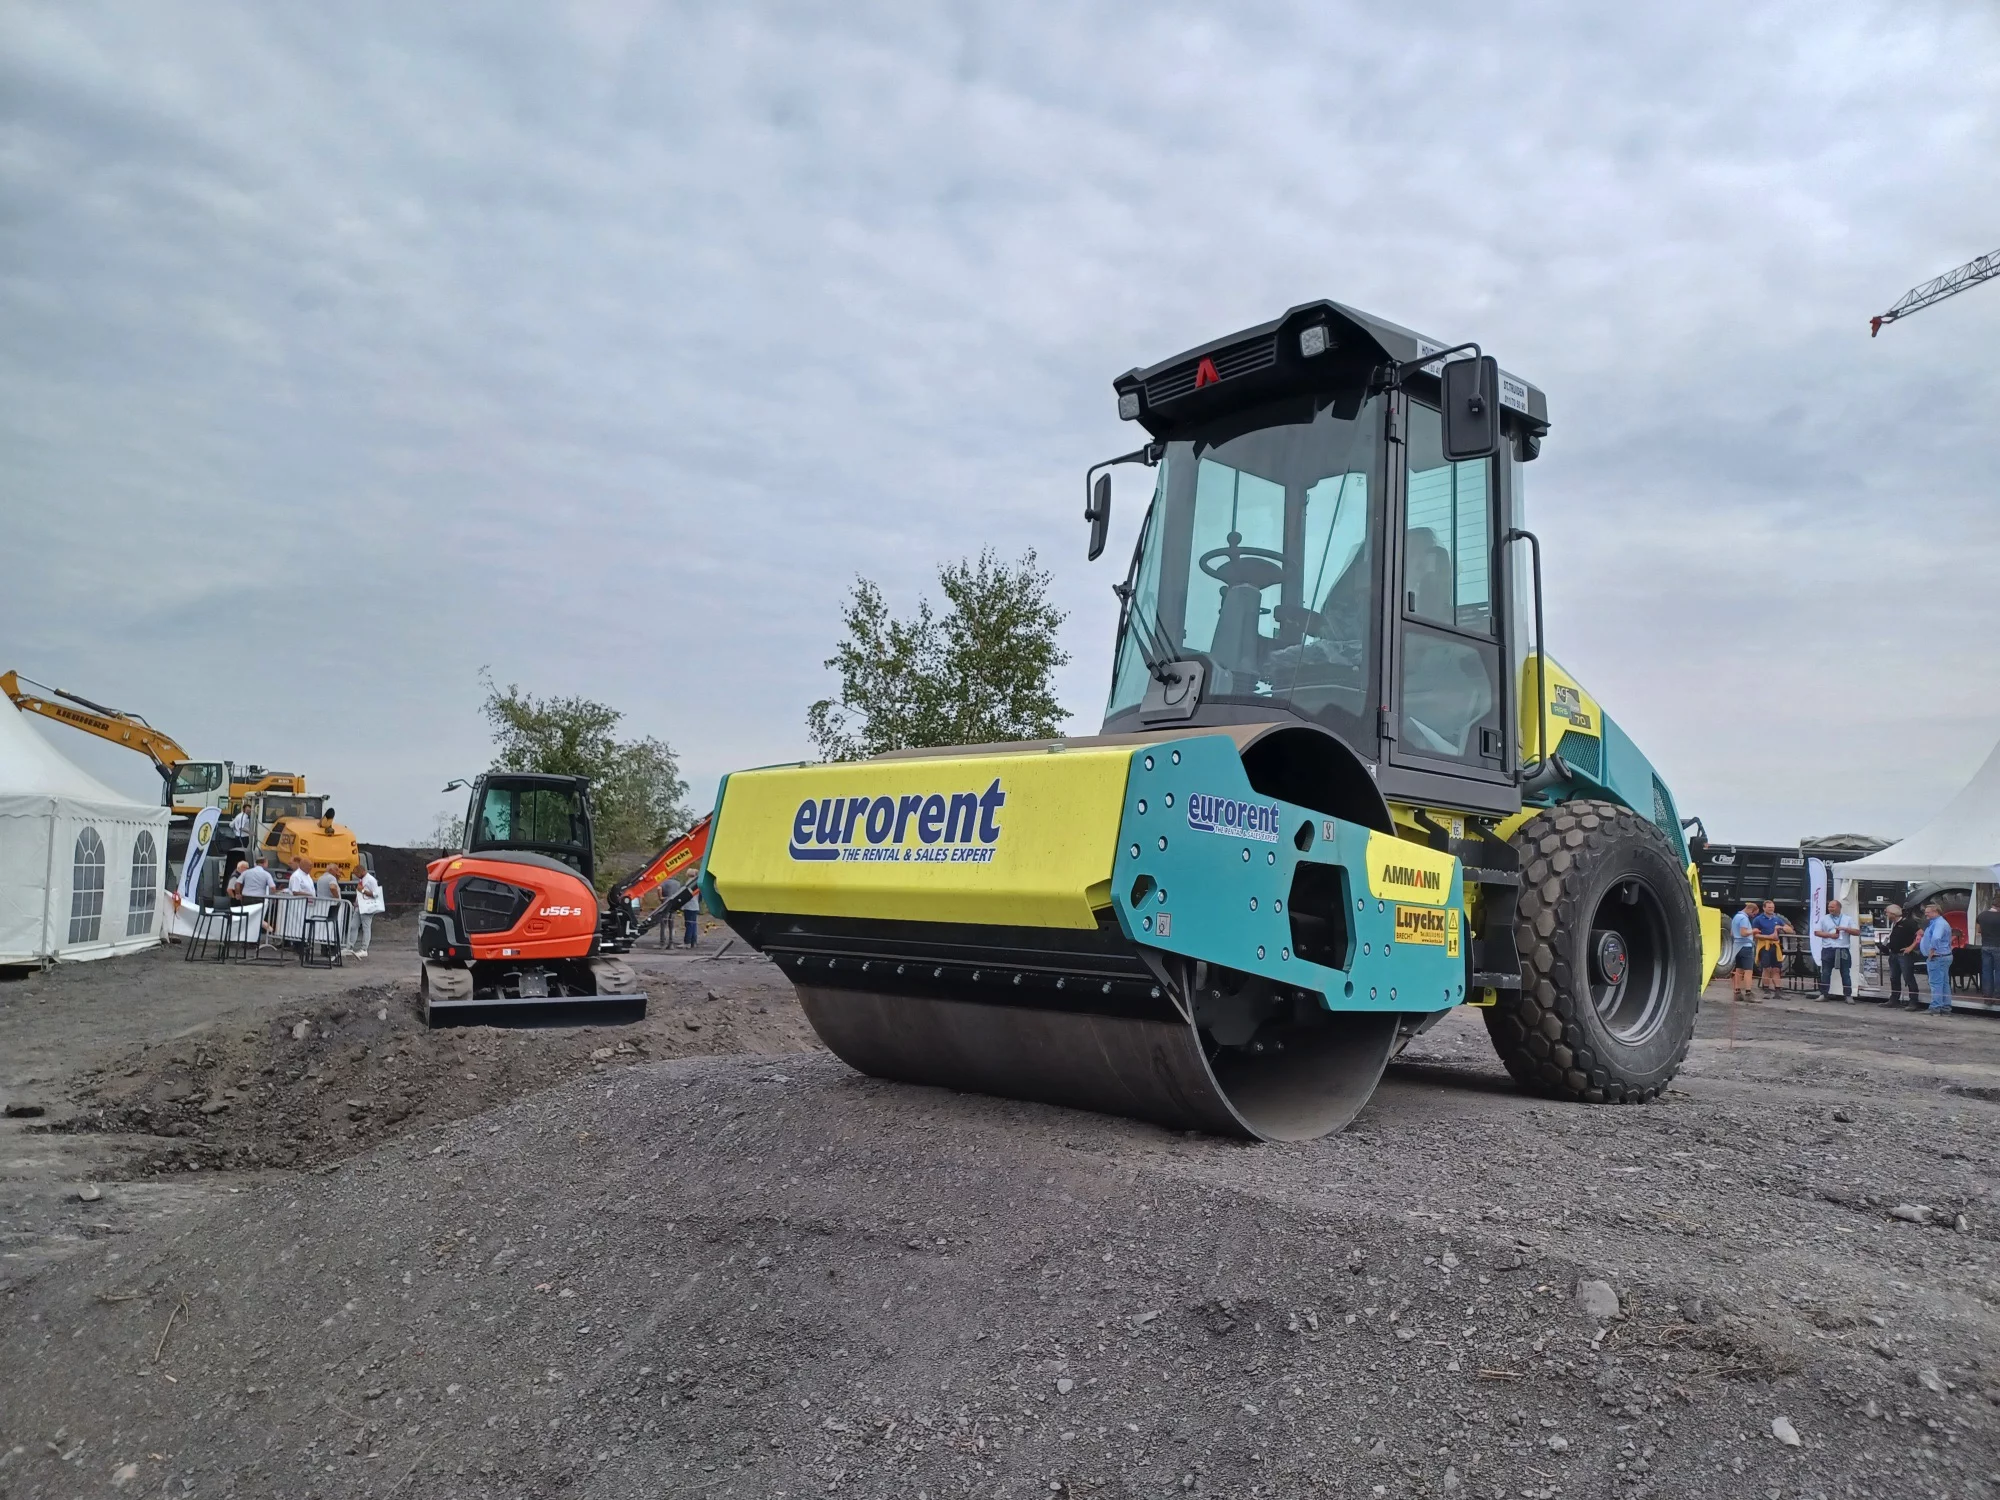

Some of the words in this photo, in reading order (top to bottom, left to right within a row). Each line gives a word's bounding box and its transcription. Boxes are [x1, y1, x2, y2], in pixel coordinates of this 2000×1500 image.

[1574, 715, 1587, 725] 70
[793, 778, 1005, 845] eurorent
[1188, 793, 1279, 834] eurorent
[842, 848, 861, 861] THE
[861, 848, 900, 861] RENTAL
[903, 848, 911, 861] &
[914, 848, 948, 862] SALES
[950, 848, 996, 862] EXPERT
[1382, 864, 1440, 890] AMMANN
[1396, 907, 1444, 933] Luyckx
[1396, 932, 1414, 940] BRECHT
